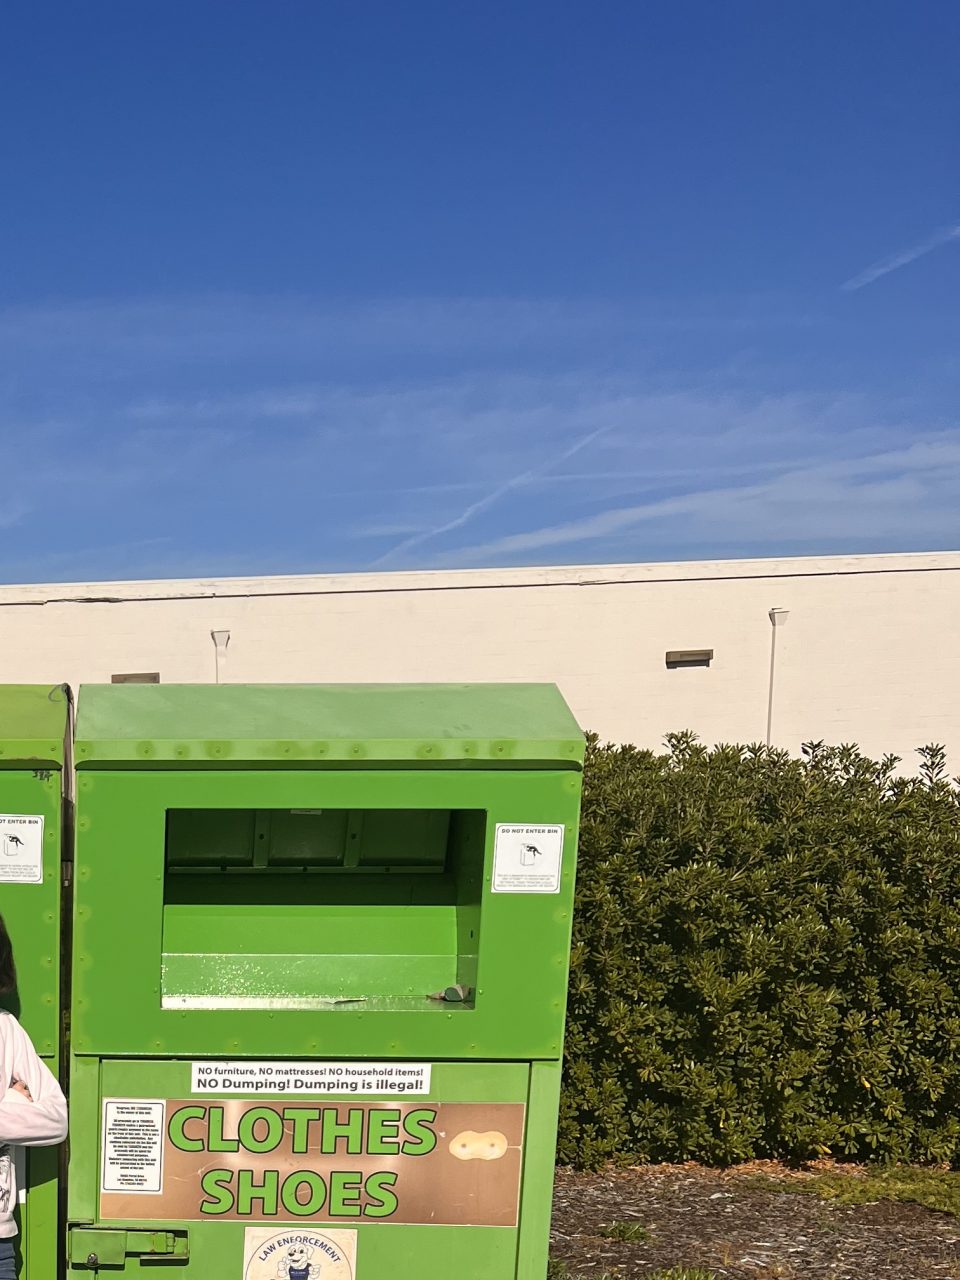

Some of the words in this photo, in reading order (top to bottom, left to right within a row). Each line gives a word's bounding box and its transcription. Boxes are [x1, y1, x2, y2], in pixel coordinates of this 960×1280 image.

[197, 1078, 218, 1088] NO
[222, 1078, 290, 1091] Dumping!
[294, 1079, 358, 1092] Dumping
[362, 1080, 372, 1090] is
[376, 1080, 423, 1092] illegal!
[214, 1067, 256, 1076] furniture,
[275, 1068, 327, 1076] mattresses!
[328, 1068, 343, 1076] NO
[345, 1068, 393, 1076] household
[395, 1068, 424, 1076] items!
[168, 1105, 438, 1156] CLOTHES
[200, 1168, 398, 1218] SHOES
[258, 1243, 276, 1262] LAW
[277, 1235, 341, 1263] ENFORCEMENT
